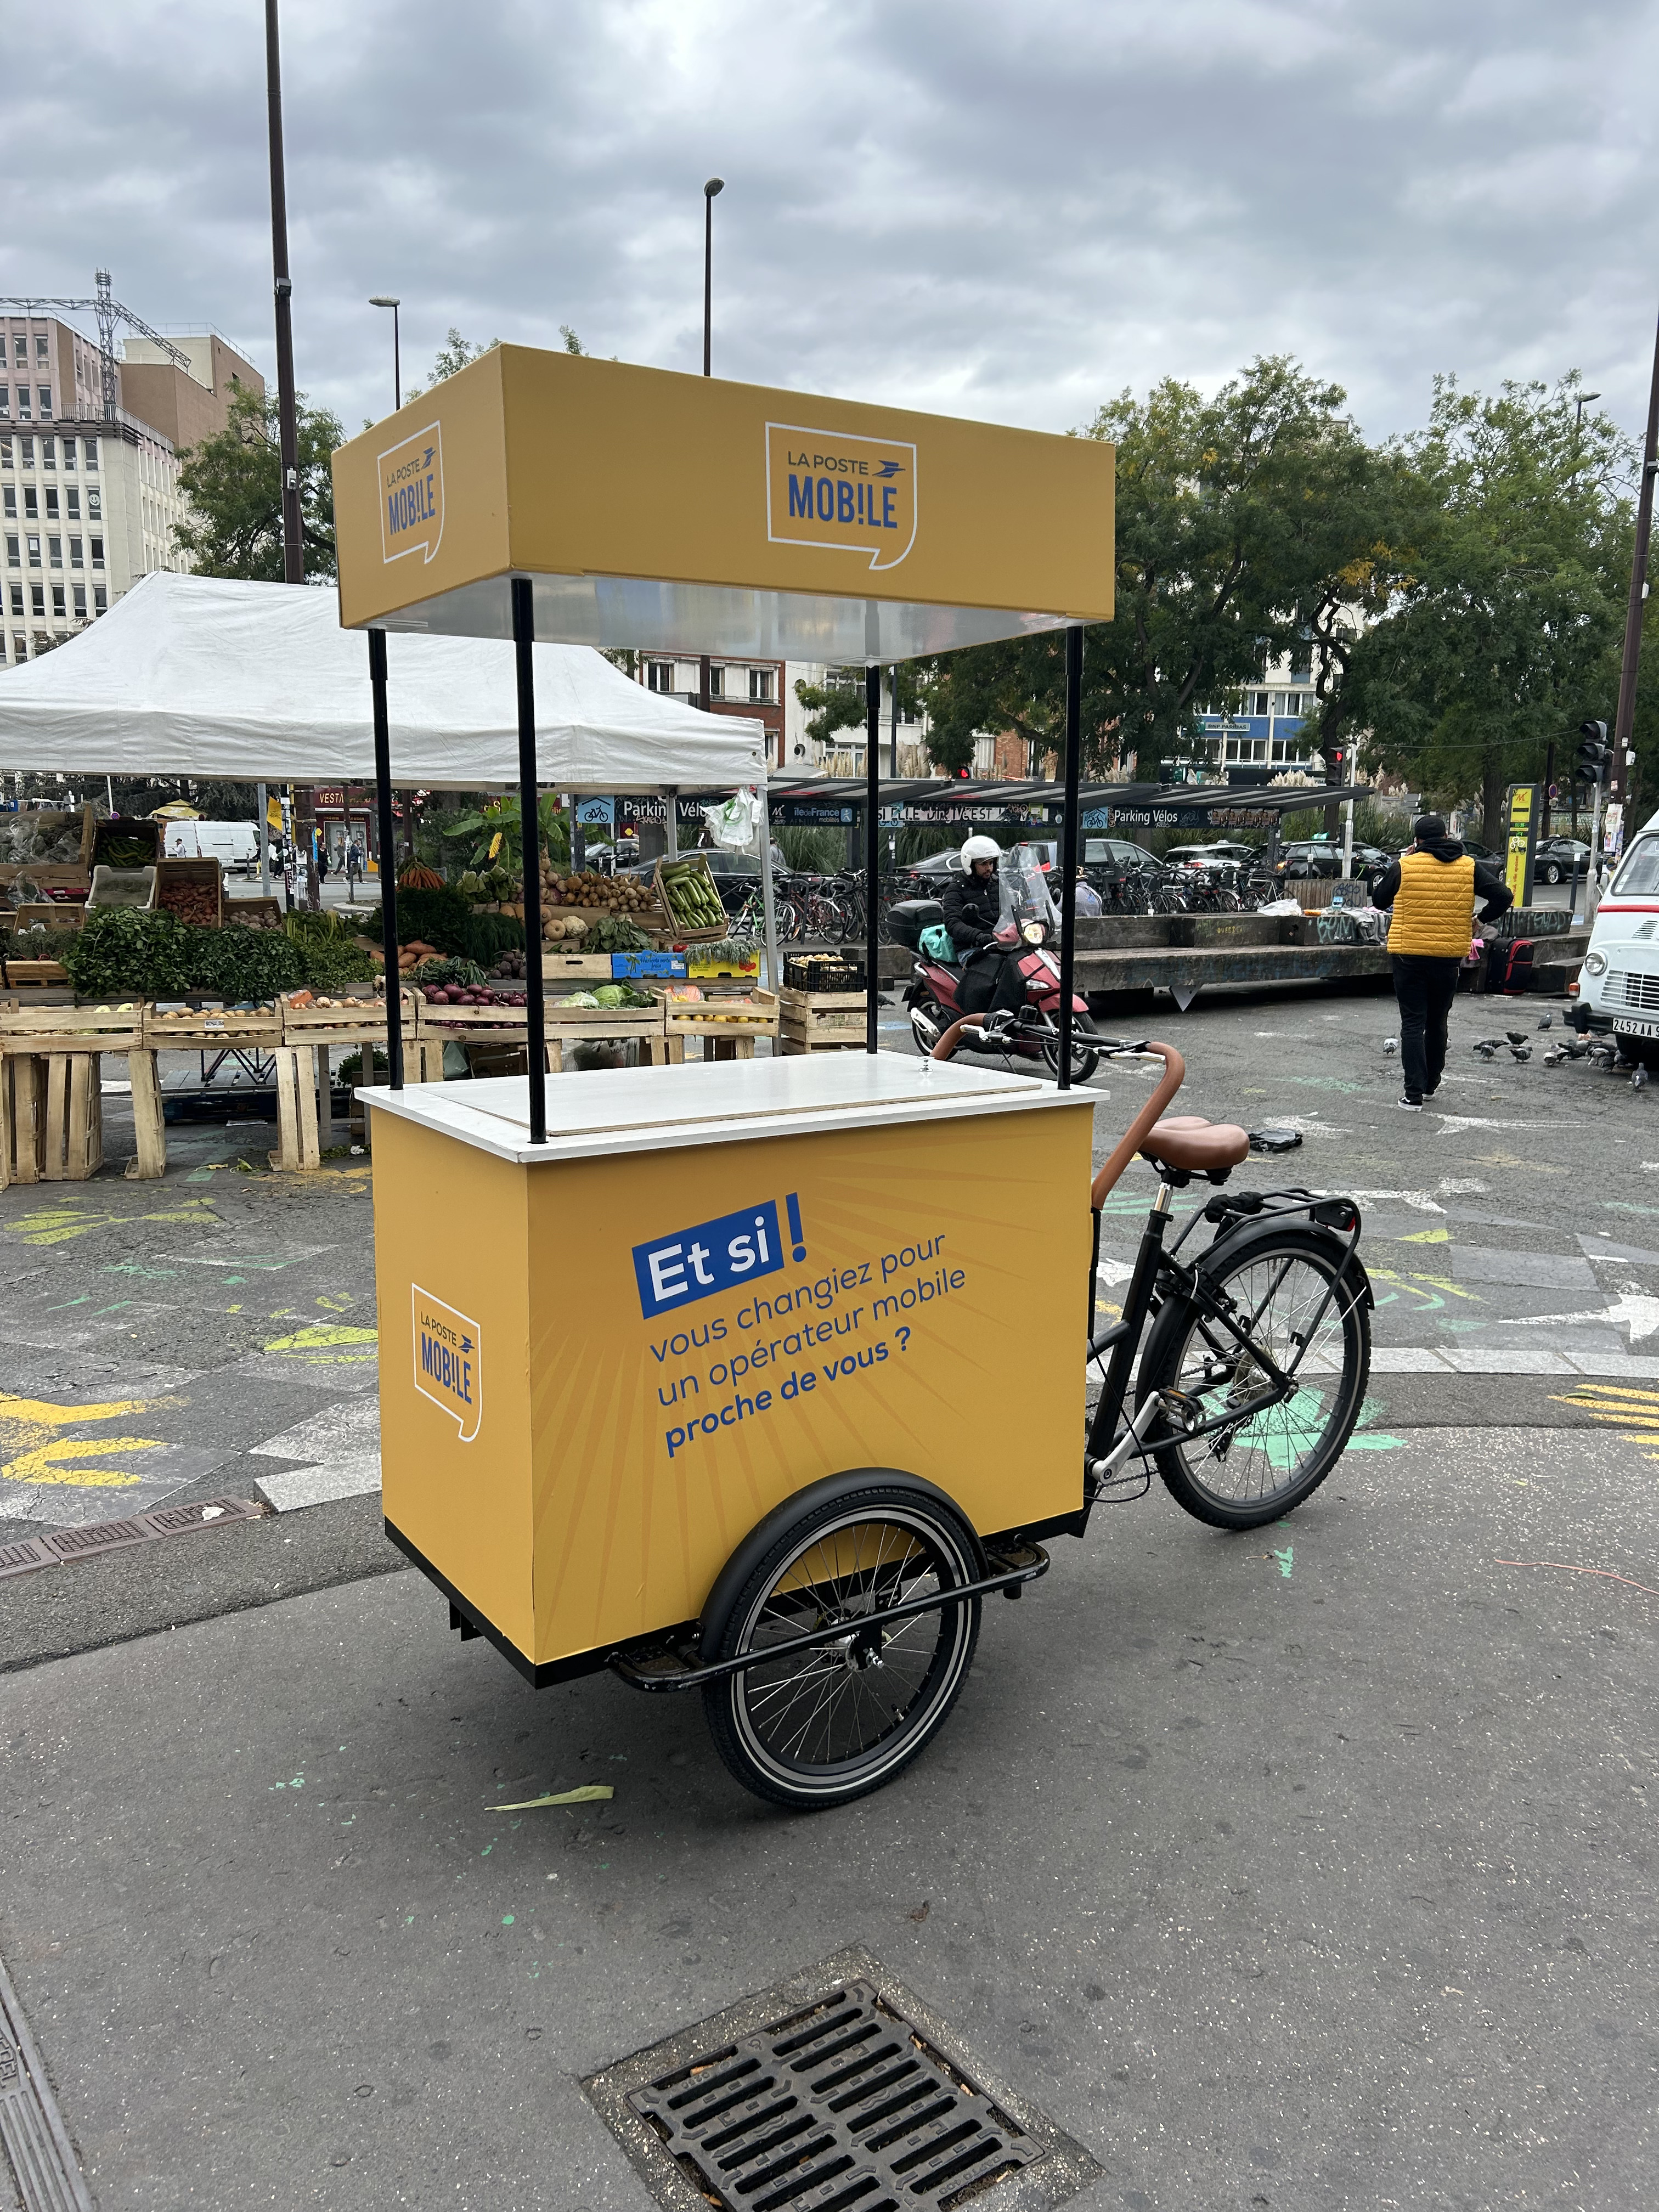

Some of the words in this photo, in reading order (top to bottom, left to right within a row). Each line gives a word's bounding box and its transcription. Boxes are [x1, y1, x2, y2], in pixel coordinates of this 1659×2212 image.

[386, 472, 396, 488] LA
[397, 458, 420, 484] POSTE
[788, 450, 810, 468] LA
[814, 454, 869, 476] POSTE
[623, 801, 667, 816] Parkin
[1114, 809, 1150, 825] Parking
[1153, 810, 1178, 822] Vélos
[1613, 1019, 1638, 1034] 2452
[1640, 1023, 1652, 1037] AA
[647, 1242, 715, 1302] Et
[727, 1215, 770, 1273] si
[785, 1191, 807, 1262] !
[650, 1318, 729, 1363] vous
[737, 1262, 873, 1329] changiez
[880, 1233, 946, 1283] pour
[421, 1311, 431, 1330] LA
[431, 1318, 457, 1347] POSTE
[657, 1375, 699, 1407] un
[708, 1307, 865, 1387] opérateur
[872, 1267, 966, 1322] mobile
[665, 1390, 773, 1459] proche
[780, 1370, 817, 1401] de
[822, 1341, 890, 1382] vous
[894, 1326, 912, 1352] ?
